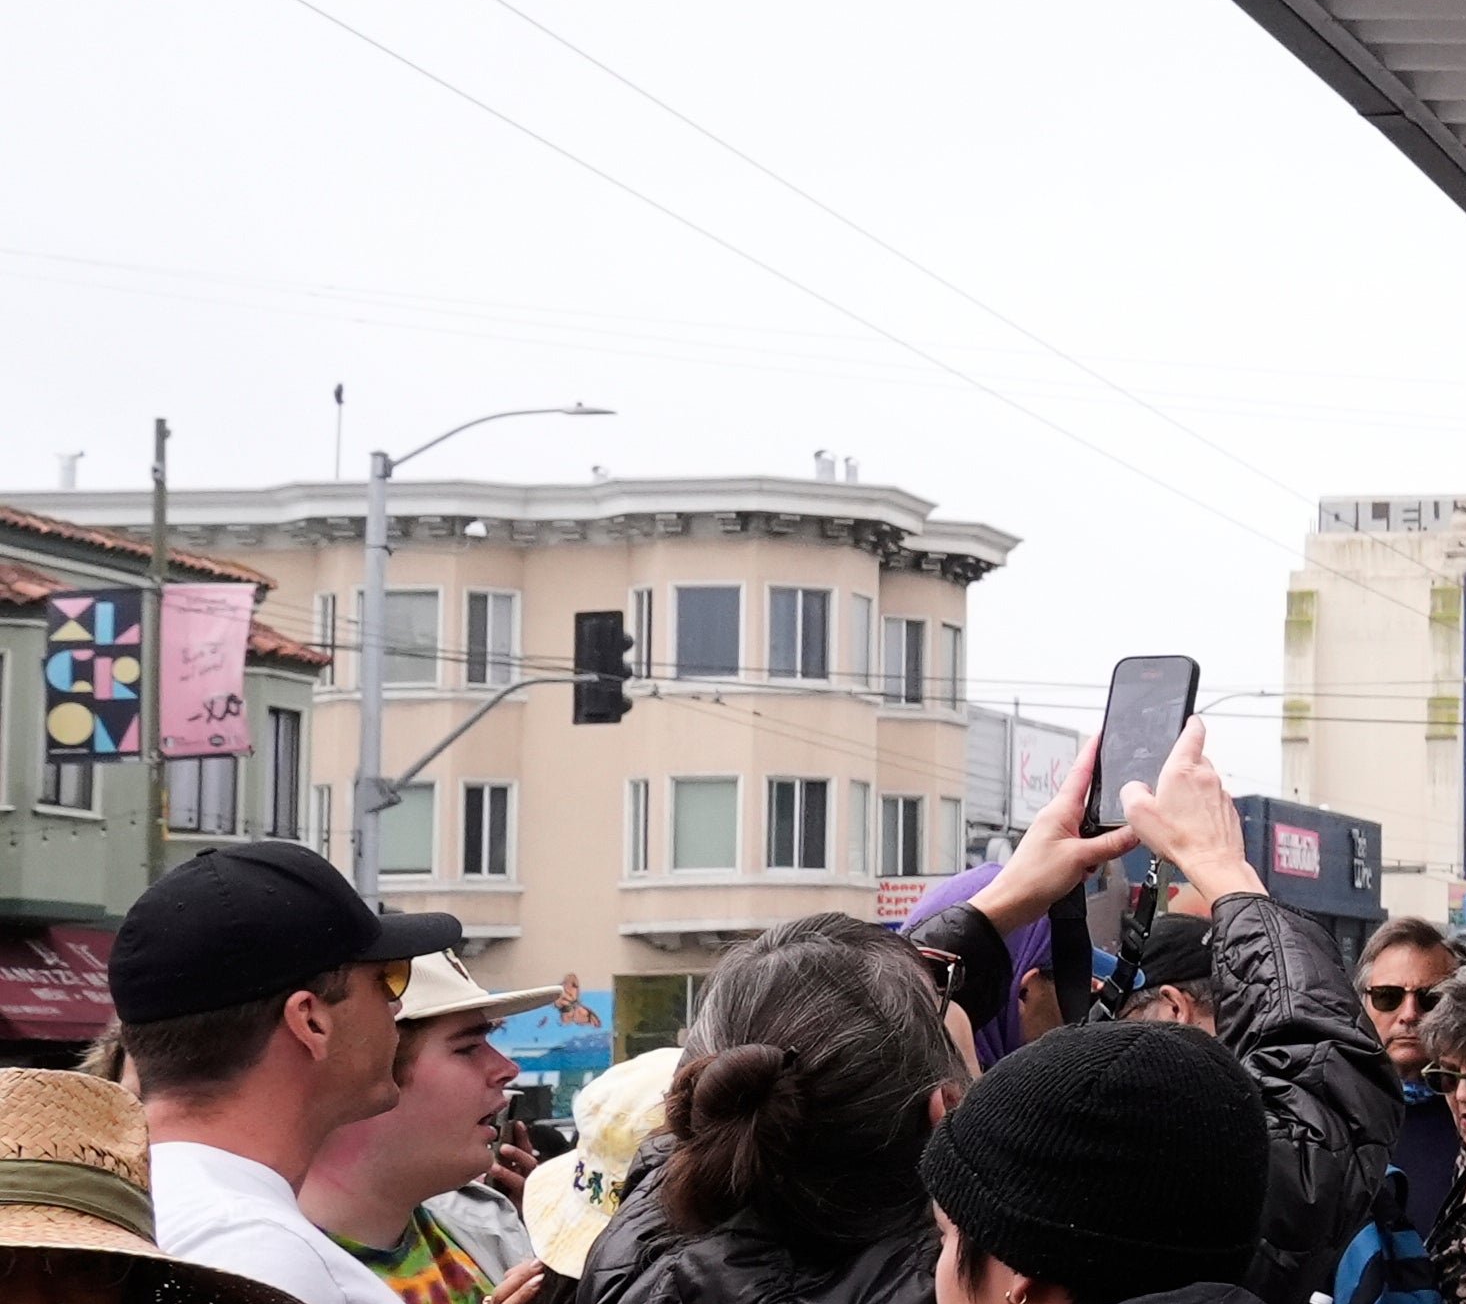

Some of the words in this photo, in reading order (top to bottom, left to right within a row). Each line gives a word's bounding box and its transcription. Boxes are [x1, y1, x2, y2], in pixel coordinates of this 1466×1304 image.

[880, 881, 927, 895] Money
[877, 893, 918, 905] Expre
[877, 906, 909, 916] Cent
